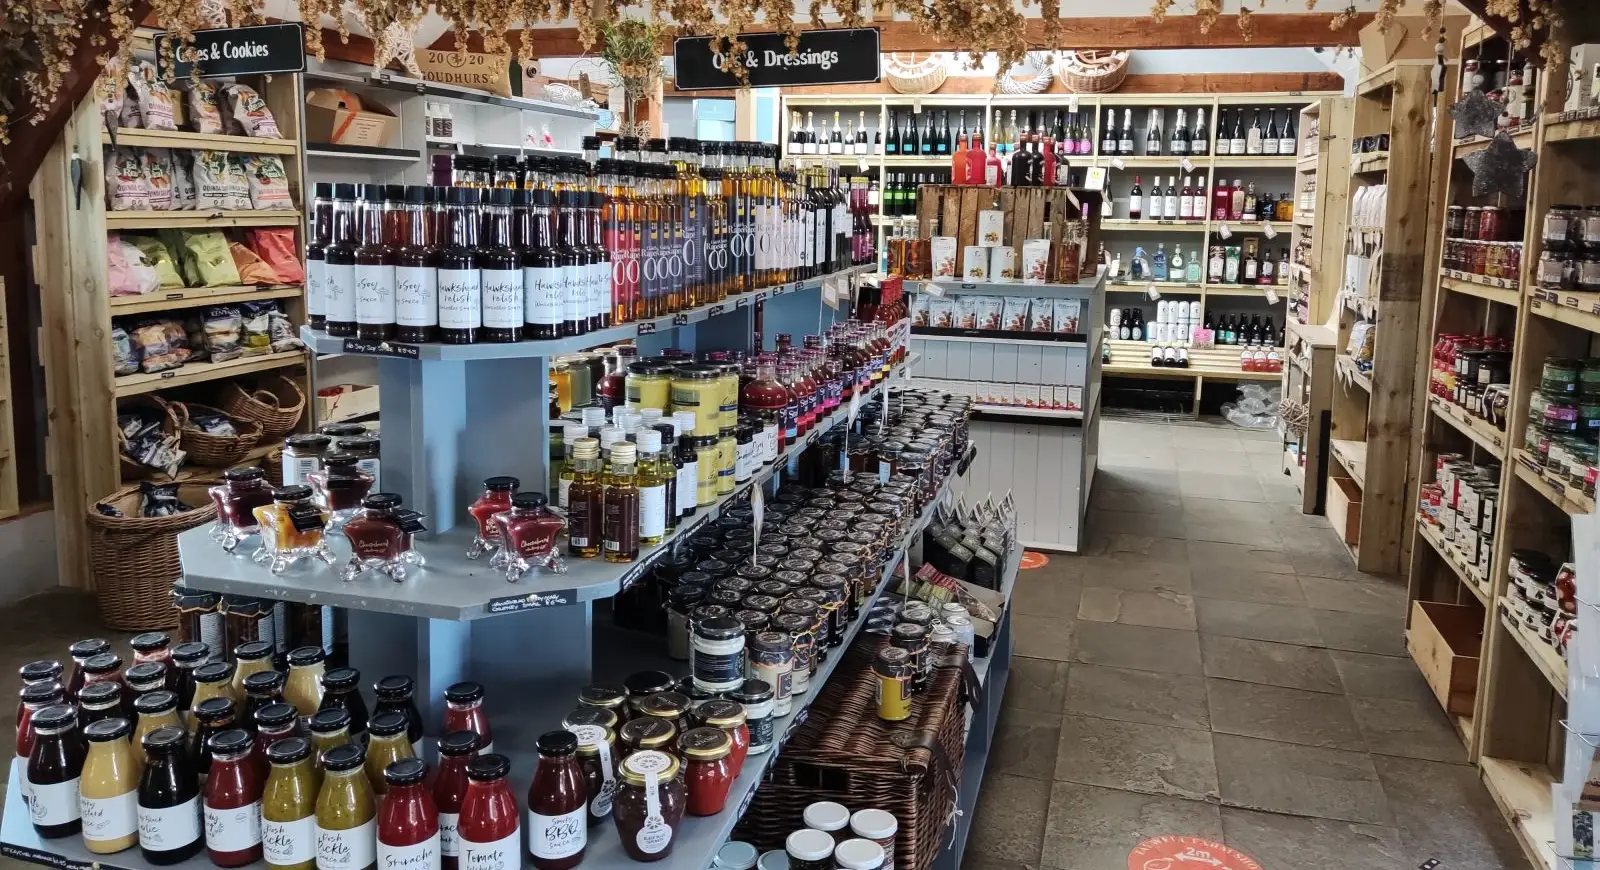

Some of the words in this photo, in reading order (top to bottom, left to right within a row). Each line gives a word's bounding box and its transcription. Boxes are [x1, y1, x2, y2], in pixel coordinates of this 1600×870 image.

[175, 45, 209, 63] Ces
[210, 42, 221, 60] &
[223, 41, 269, 59] Cookies
[428, 52, 444, 64] 20
[469, 55, 484, 65] 20
[745, 50, 759, 68] &
[764, 47, 839, 70] Dressings
[483, 281, 523, 293] Hawkshea
[265, 825, 285, 835] Posh
[545, 819, 579, 841] BBQ
[322, 832, 342, 842] Posh
[317, 837, 350, 854] Pickle
[465, 849, 503, 863] Tomato
[1185, 846, 1211, 859] 2m
